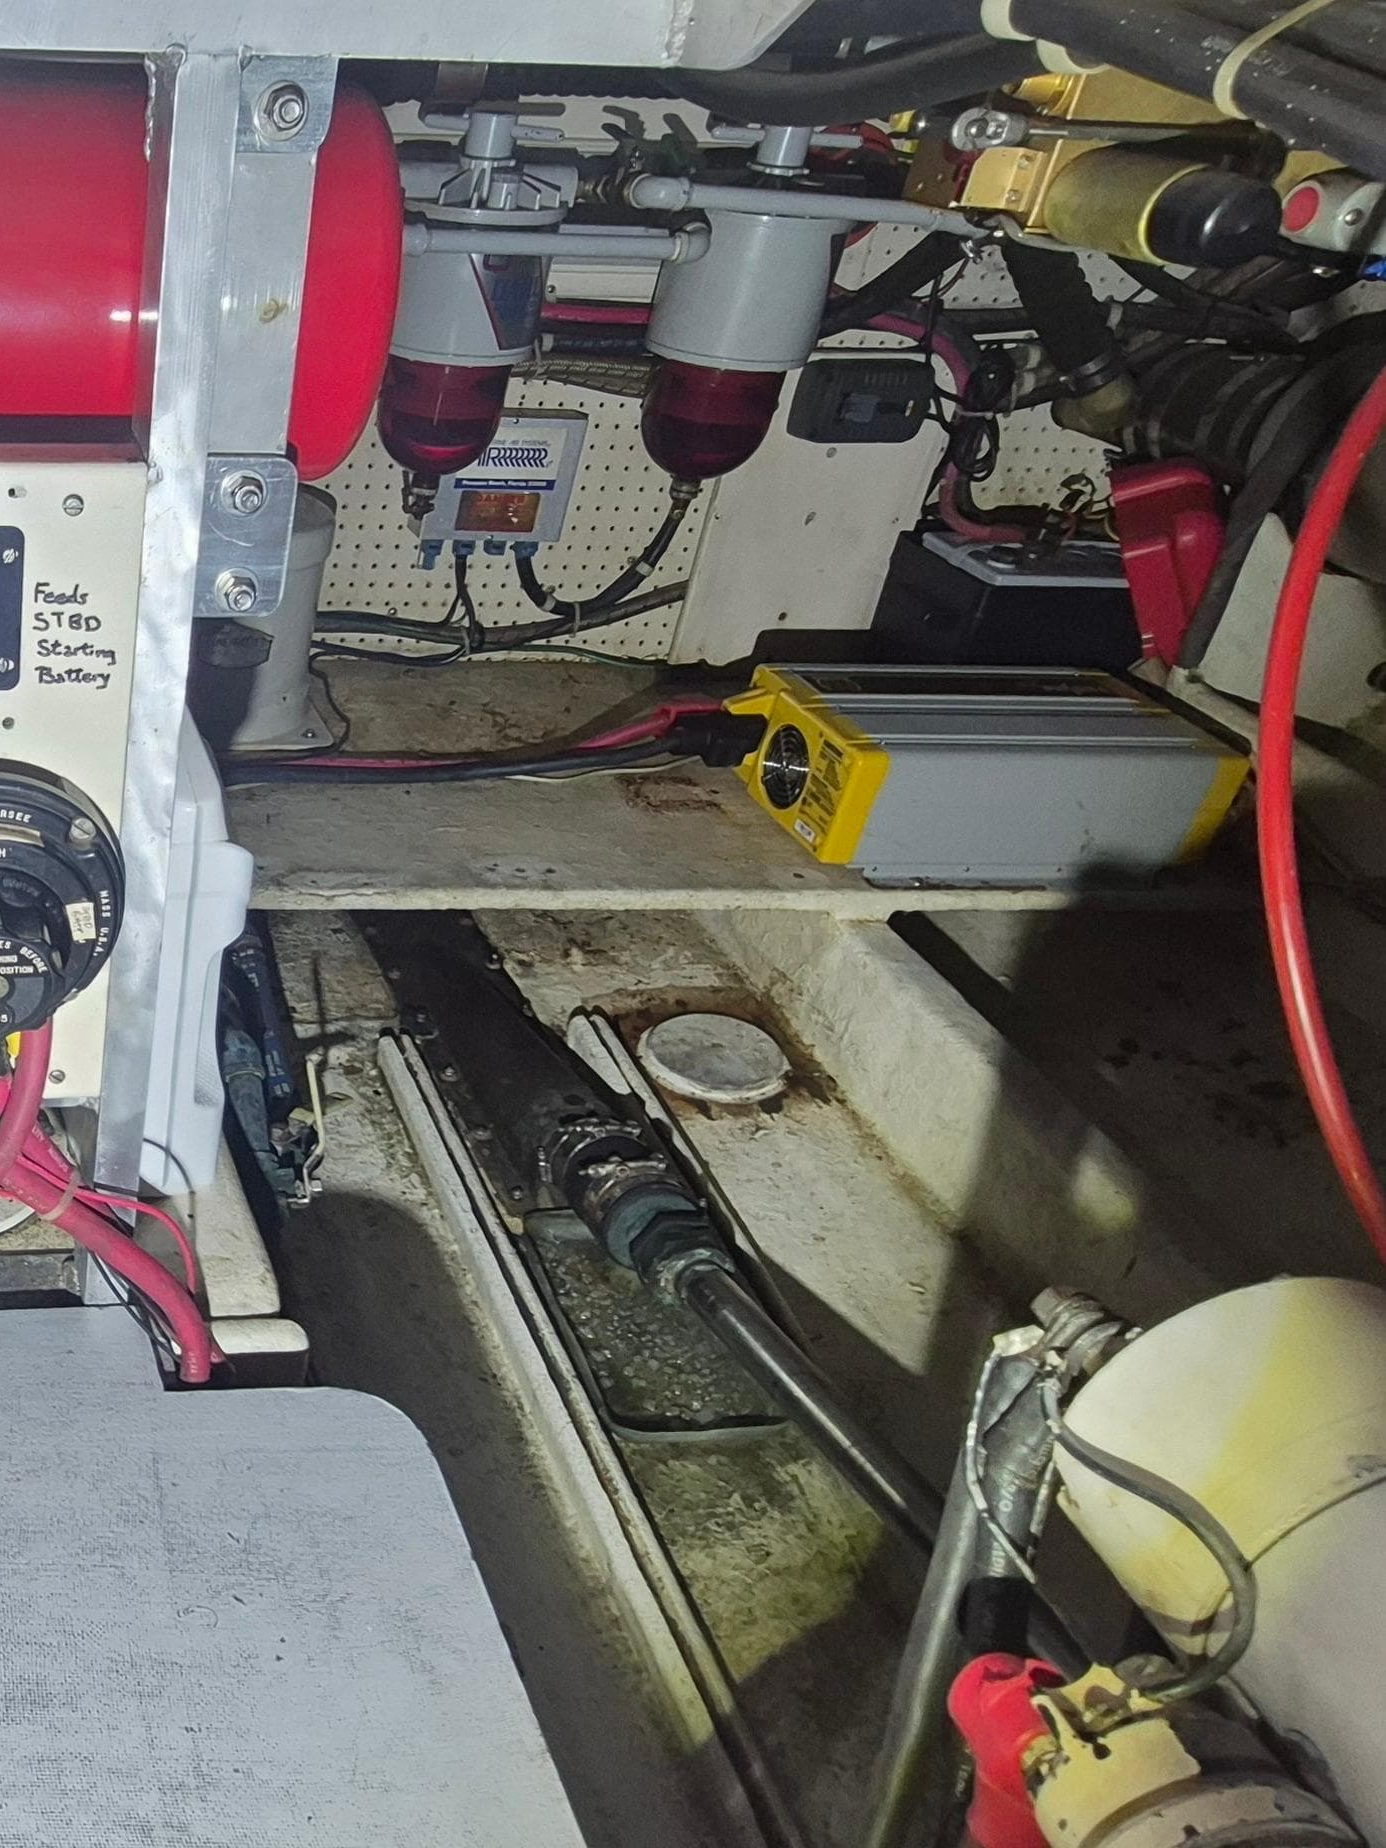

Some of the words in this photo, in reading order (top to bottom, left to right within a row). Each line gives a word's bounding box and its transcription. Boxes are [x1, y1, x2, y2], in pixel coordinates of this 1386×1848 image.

[34, 581, 89, 605] Feeds
[32, 611, 102, 632] STBD
[37, 638, 117, 666] Starting
[34, 665, 111, 690] Battery
